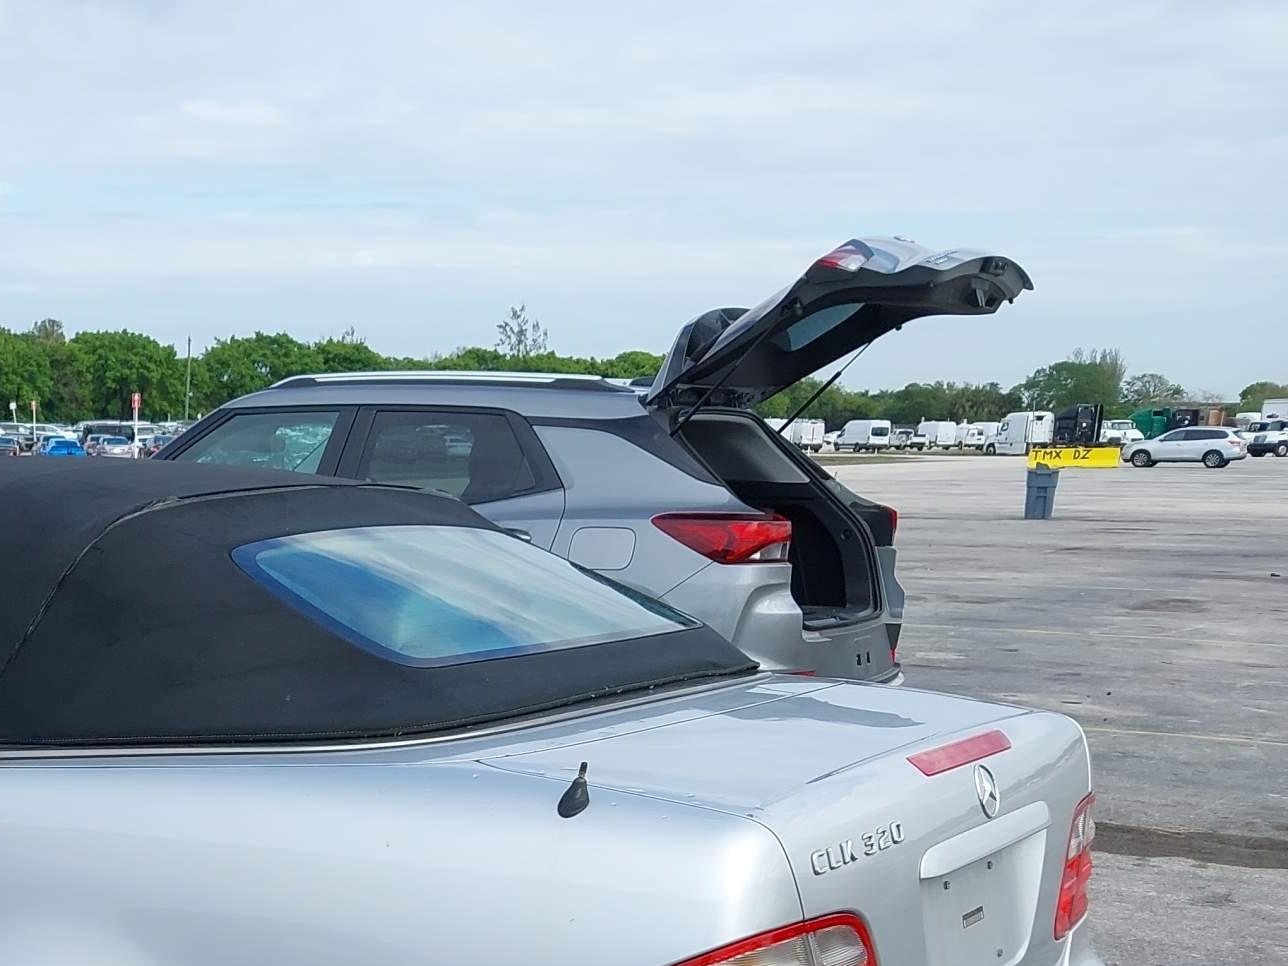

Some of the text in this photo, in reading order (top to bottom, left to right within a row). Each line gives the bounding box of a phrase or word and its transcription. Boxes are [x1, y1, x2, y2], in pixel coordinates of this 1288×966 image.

[1032, 450, 1062, 460] TMX
[810, 820, 905, 876] CLK 320
